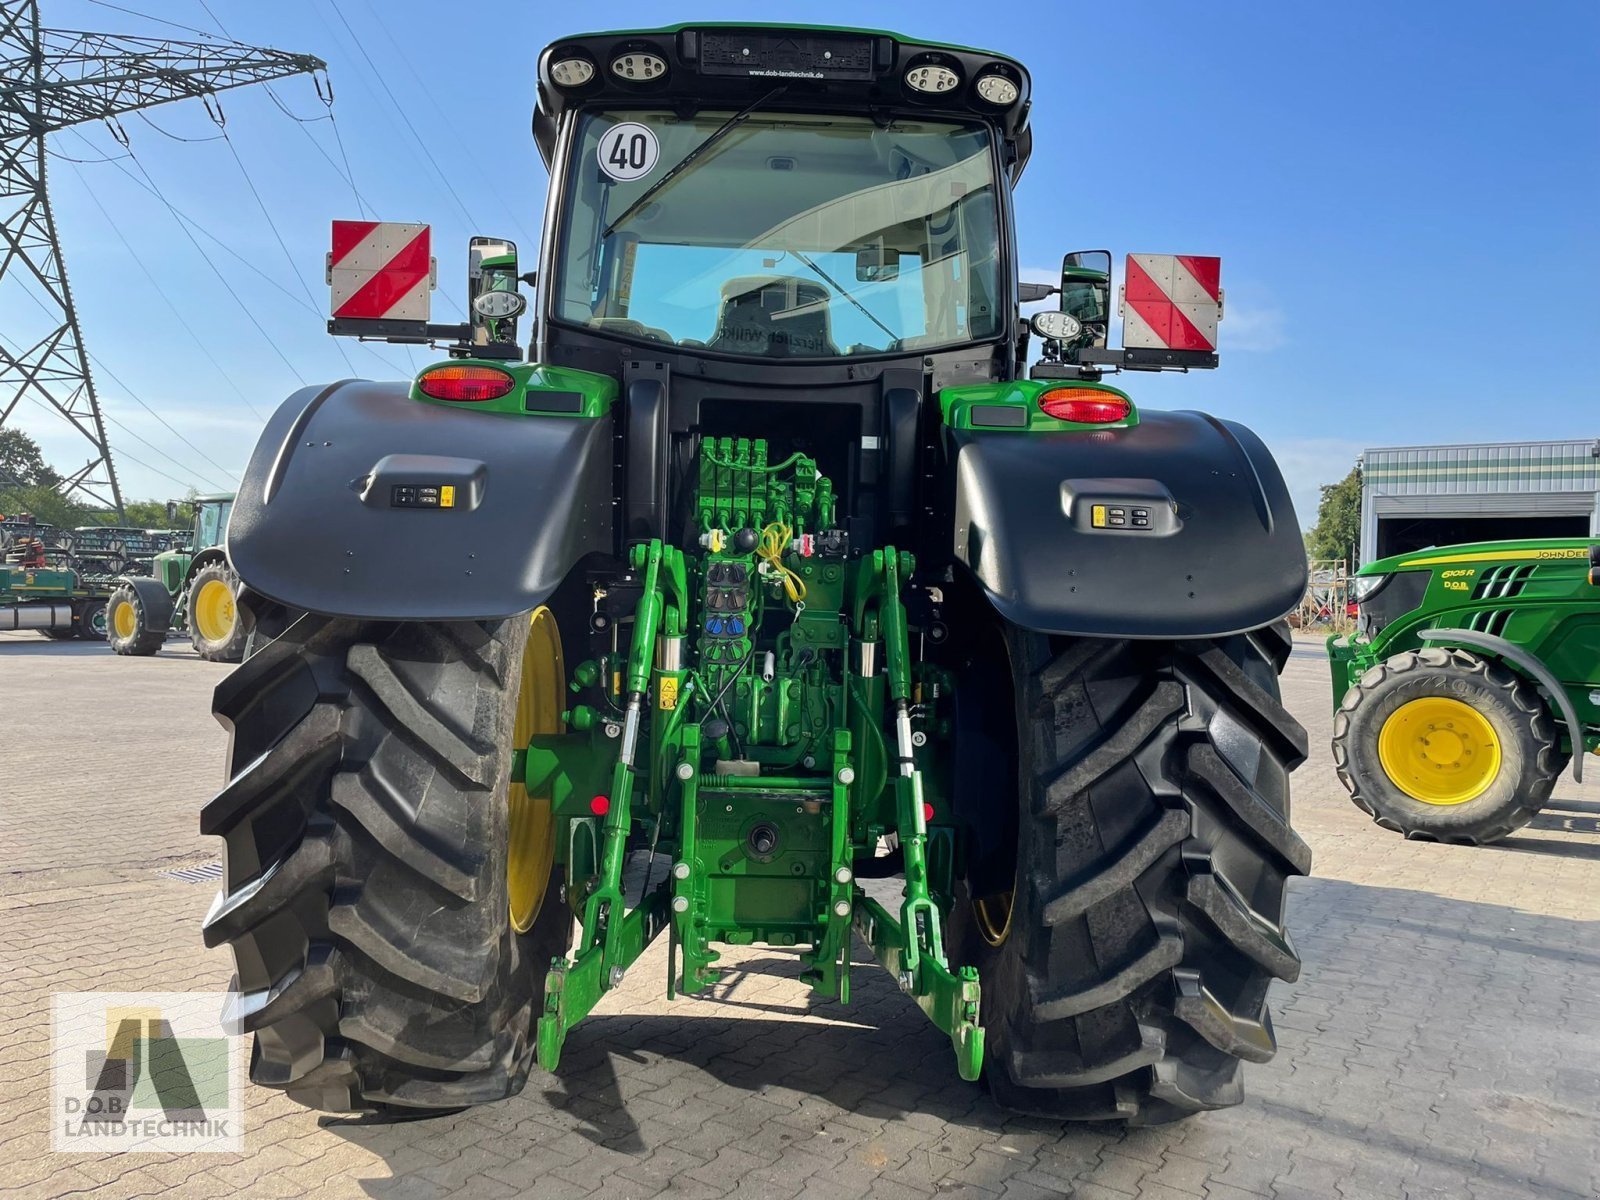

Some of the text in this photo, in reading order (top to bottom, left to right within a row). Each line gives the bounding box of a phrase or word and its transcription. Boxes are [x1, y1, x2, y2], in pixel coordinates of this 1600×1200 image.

[749, 70, 824, 79] www.dob-landtechnik.de
[609, 133, 647, 169] 40
[1536, 551, 1565, 559] JOHN
[1441, 570, 1466, 579] 6105
